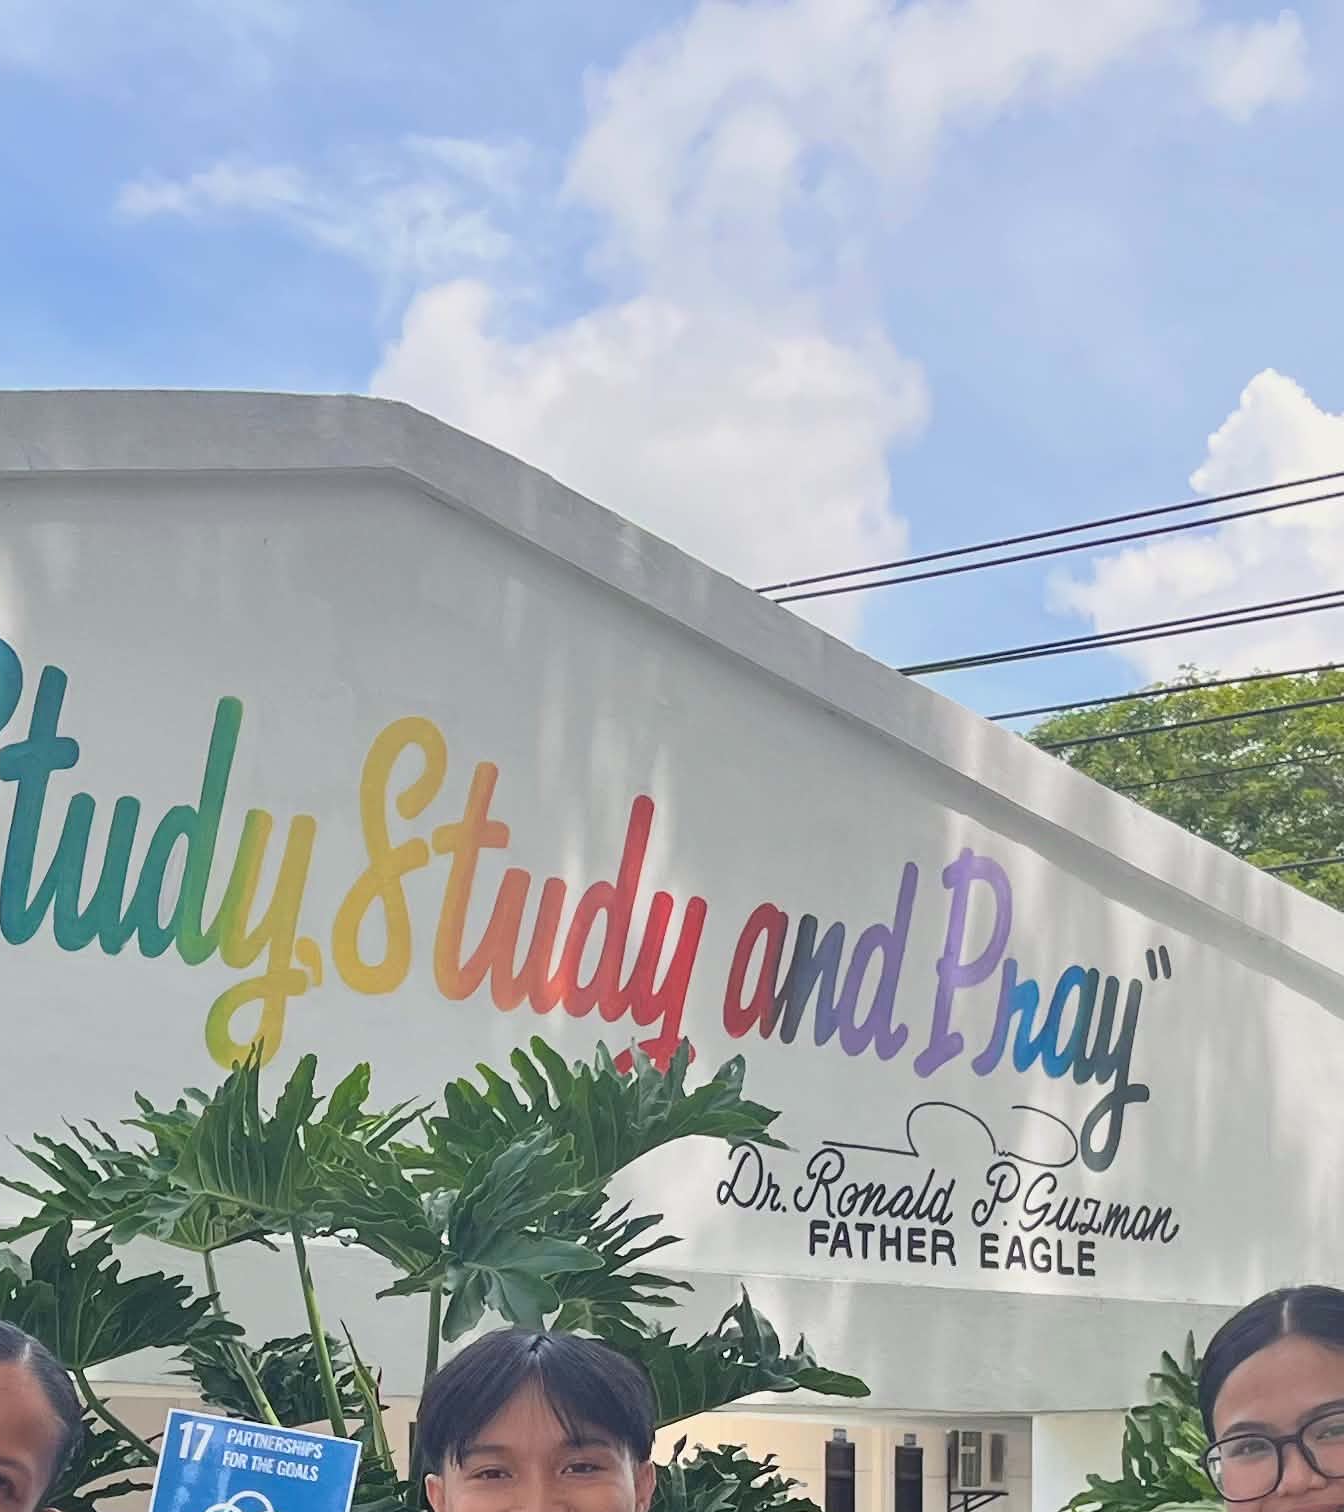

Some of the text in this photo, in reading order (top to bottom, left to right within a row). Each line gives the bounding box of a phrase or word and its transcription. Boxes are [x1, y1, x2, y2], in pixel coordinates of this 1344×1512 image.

[331, 716, 707, 1073] Study
[722, 861, 910, 1059] and
[914, 847, 1173, 1172] Pray"
[717, 1141, 1180, 1244] Dr. Ronald P. Guzman
[809, 1219, 1097, 1277] FATHER EAGLE
[179, 1420, 215, 1462] 17
[222, 1450, 320, 1482] FOR THE GOALS
[226, 1428, 324, 1460] PARTNERSHIPS
